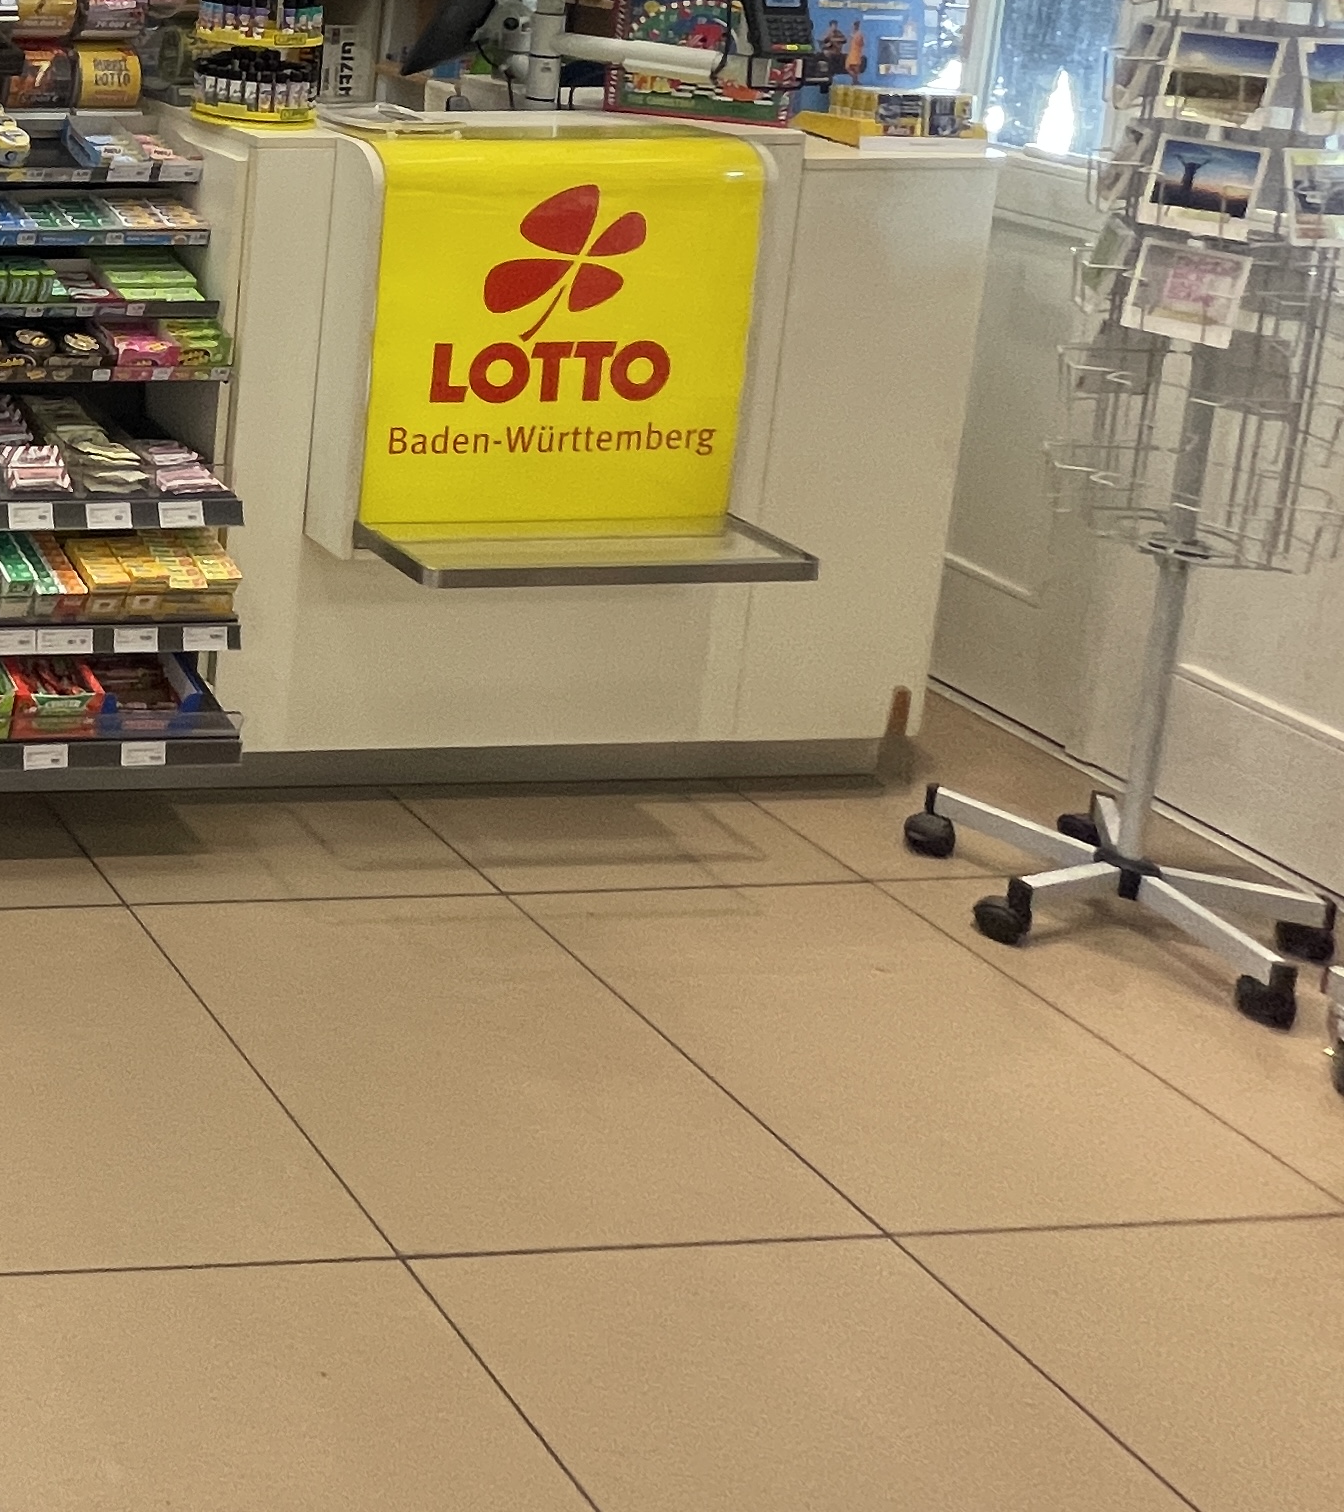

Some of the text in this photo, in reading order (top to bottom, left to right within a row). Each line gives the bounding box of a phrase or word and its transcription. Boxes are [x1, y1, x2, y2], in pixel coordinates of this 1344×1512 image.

[32, 61, 51, 87] 7
[339, 42, 355, 95] GIZEH
[429, 340, 671, 404] LOTTO
[388, 422, 717, 456] Baden-Württemberg
